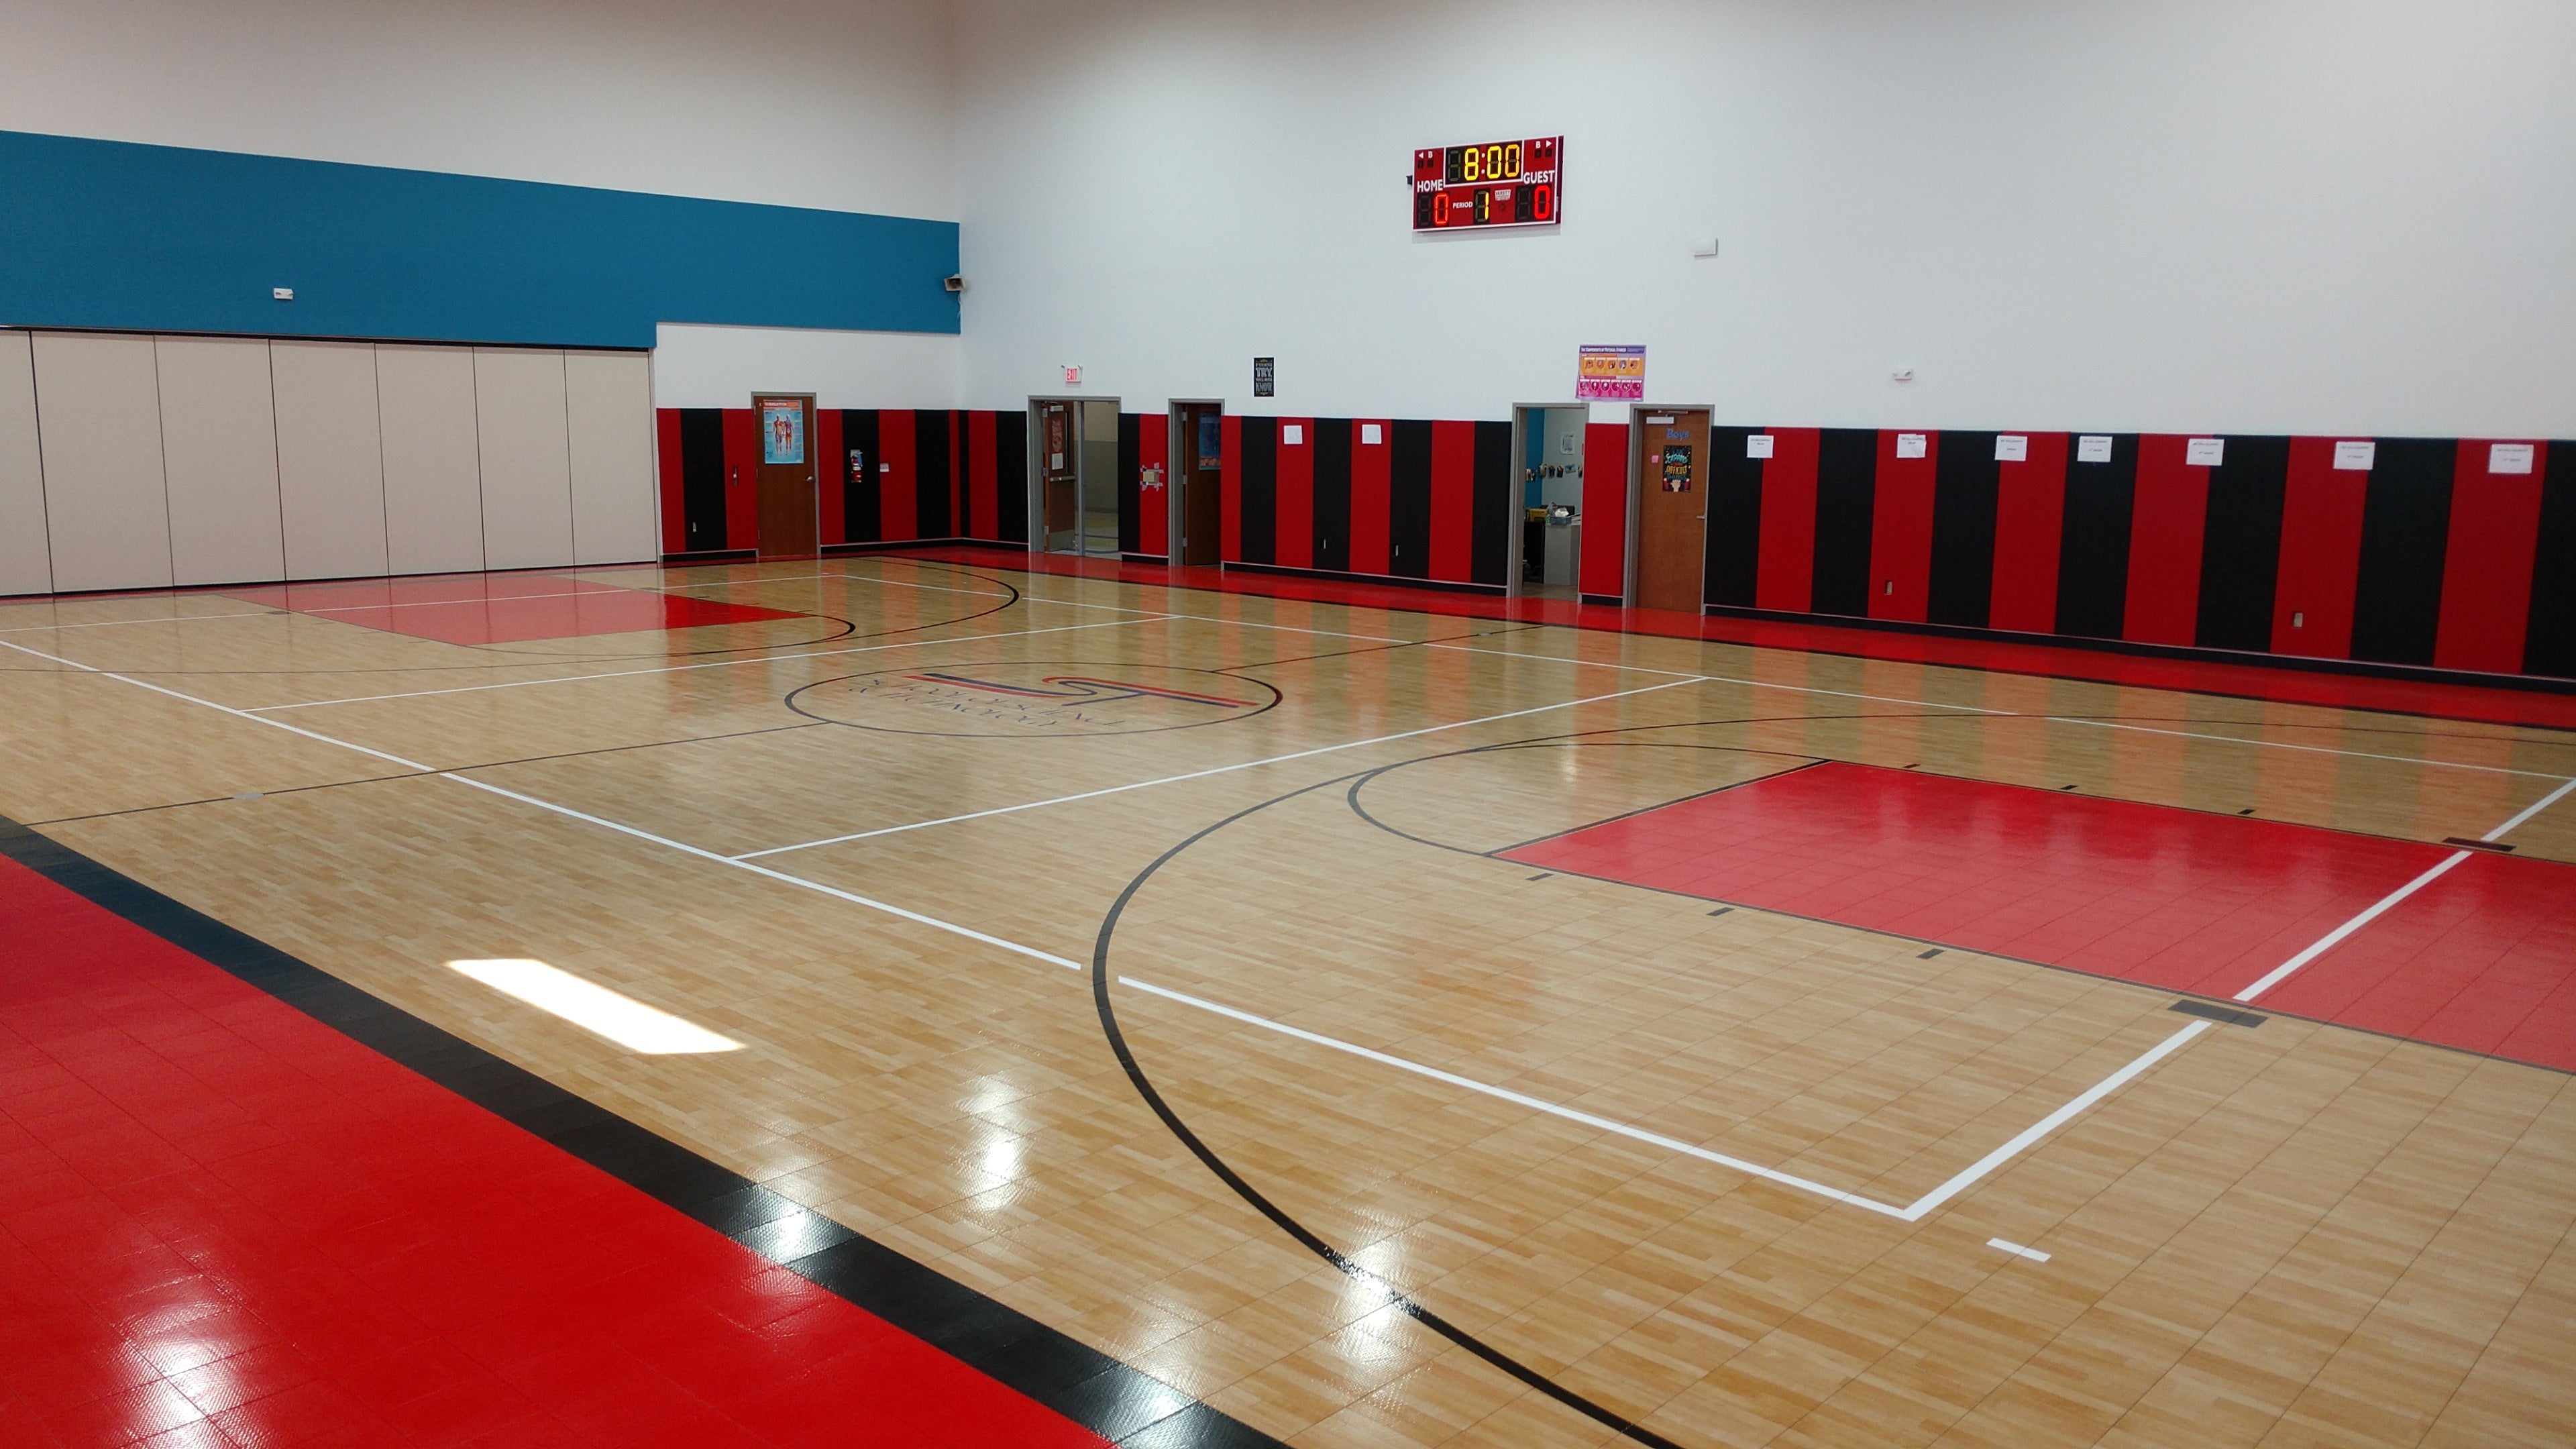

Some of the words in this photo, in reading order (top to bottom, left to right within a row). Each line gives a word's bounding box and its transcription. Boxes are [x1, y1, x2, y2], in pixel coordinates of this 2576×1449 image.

[1464, 144, 1520, 181] 8:00
[1417, 179, 1444, 193] HOME
[1523, 170, 1555, 184] GUEST
[1434, 193, 1449, 225] 0
[1452, 201, 1473, 209] PERIOD
[1485, 192, 1489, 221] 1
[1534, 185, 1550, 220] 0
[1666, 428, 1689, 441] Boys
